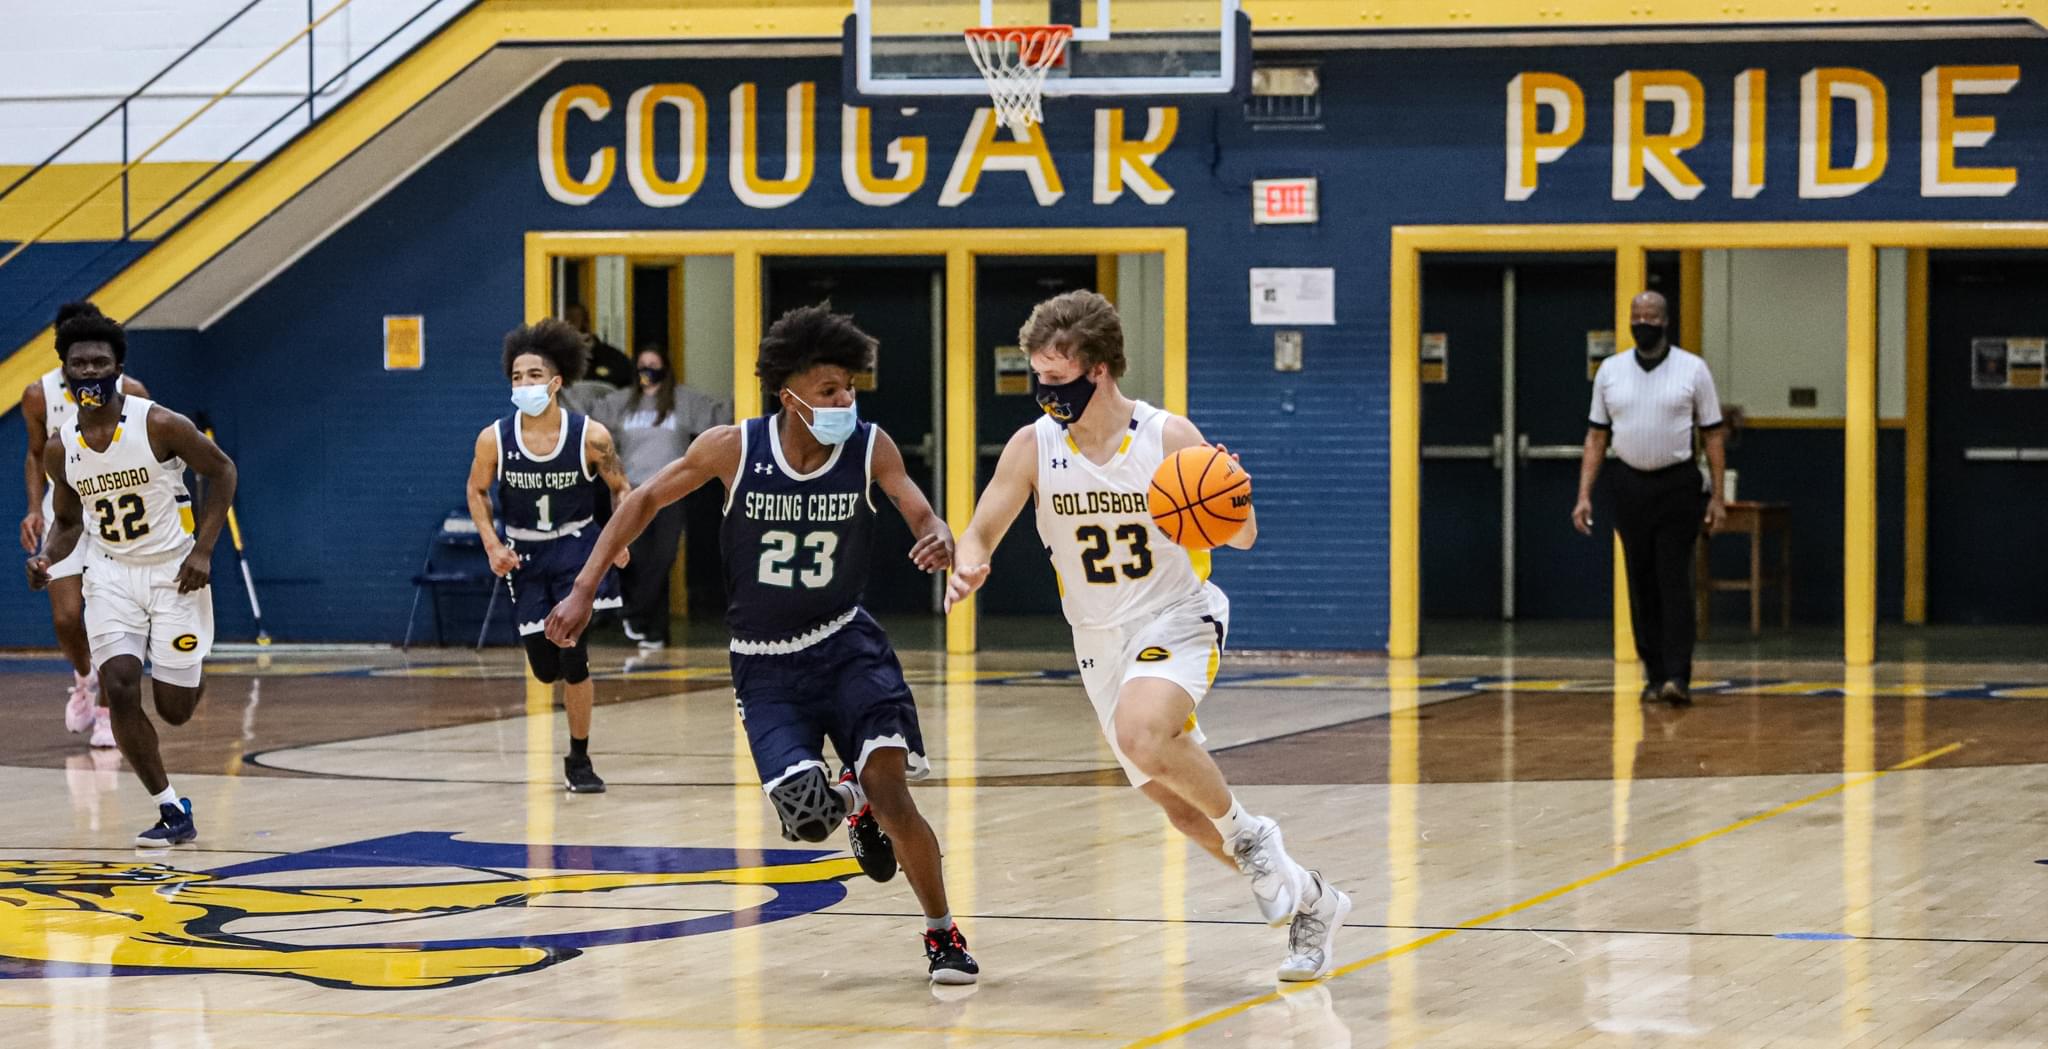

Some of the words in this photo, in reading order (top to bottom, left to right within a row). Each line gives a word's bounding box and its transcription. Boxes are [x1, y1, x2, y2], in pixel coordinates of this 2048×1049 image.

[538, 81, 1179, 207] COUGAR
[1505, 65, 2020, 201] PRIDE
[1266, 184, 1305, 216] EXIT
[76, 467, 150, 497] GOLDSBORO
[505, 471, 542, 489] SPRING
[545, 471, 579, 490] CREEK
[95, 492, 151, 542] 22
[535, 494, 553, 531] 1
[745, 491, 801, 521] SPRING
[808, 493, 859, 521] CREEK
[1053, 491, 1149, 516] GOLDSBOR
[758, 530, 838, 588] 23
[1076, 524, 1153, 584] 23
[172, 633, 198, 652] G
[1136, 646, 1170, 662] G
